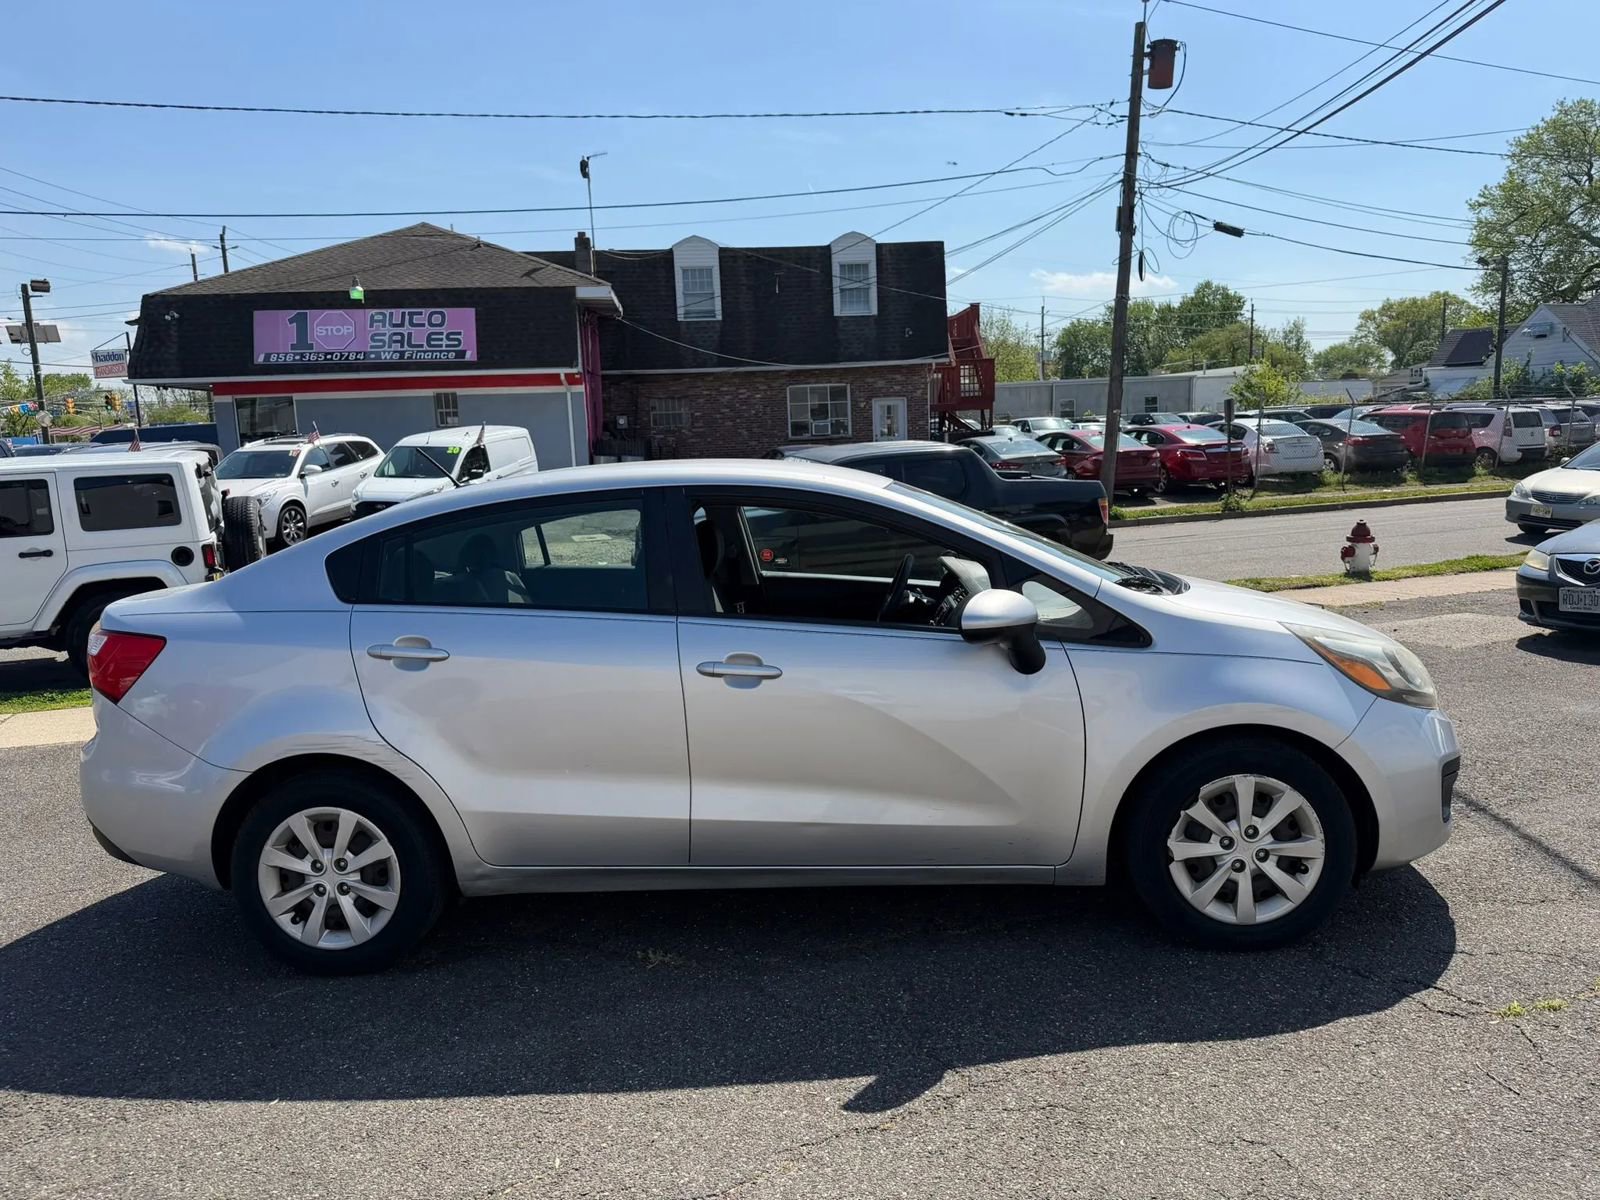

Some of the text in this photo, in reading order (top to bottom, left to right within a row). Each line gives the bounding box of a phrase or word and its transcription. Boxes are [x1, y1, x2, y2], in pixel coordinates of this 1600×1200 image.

[367, 309, 448, 330] AUTO
[287, 311, 353, 351] 1 STOP
[367, 330, 464, 351] SALES
[380, 352, 400, 360] We
[404, 351, 456, 360] Finance
